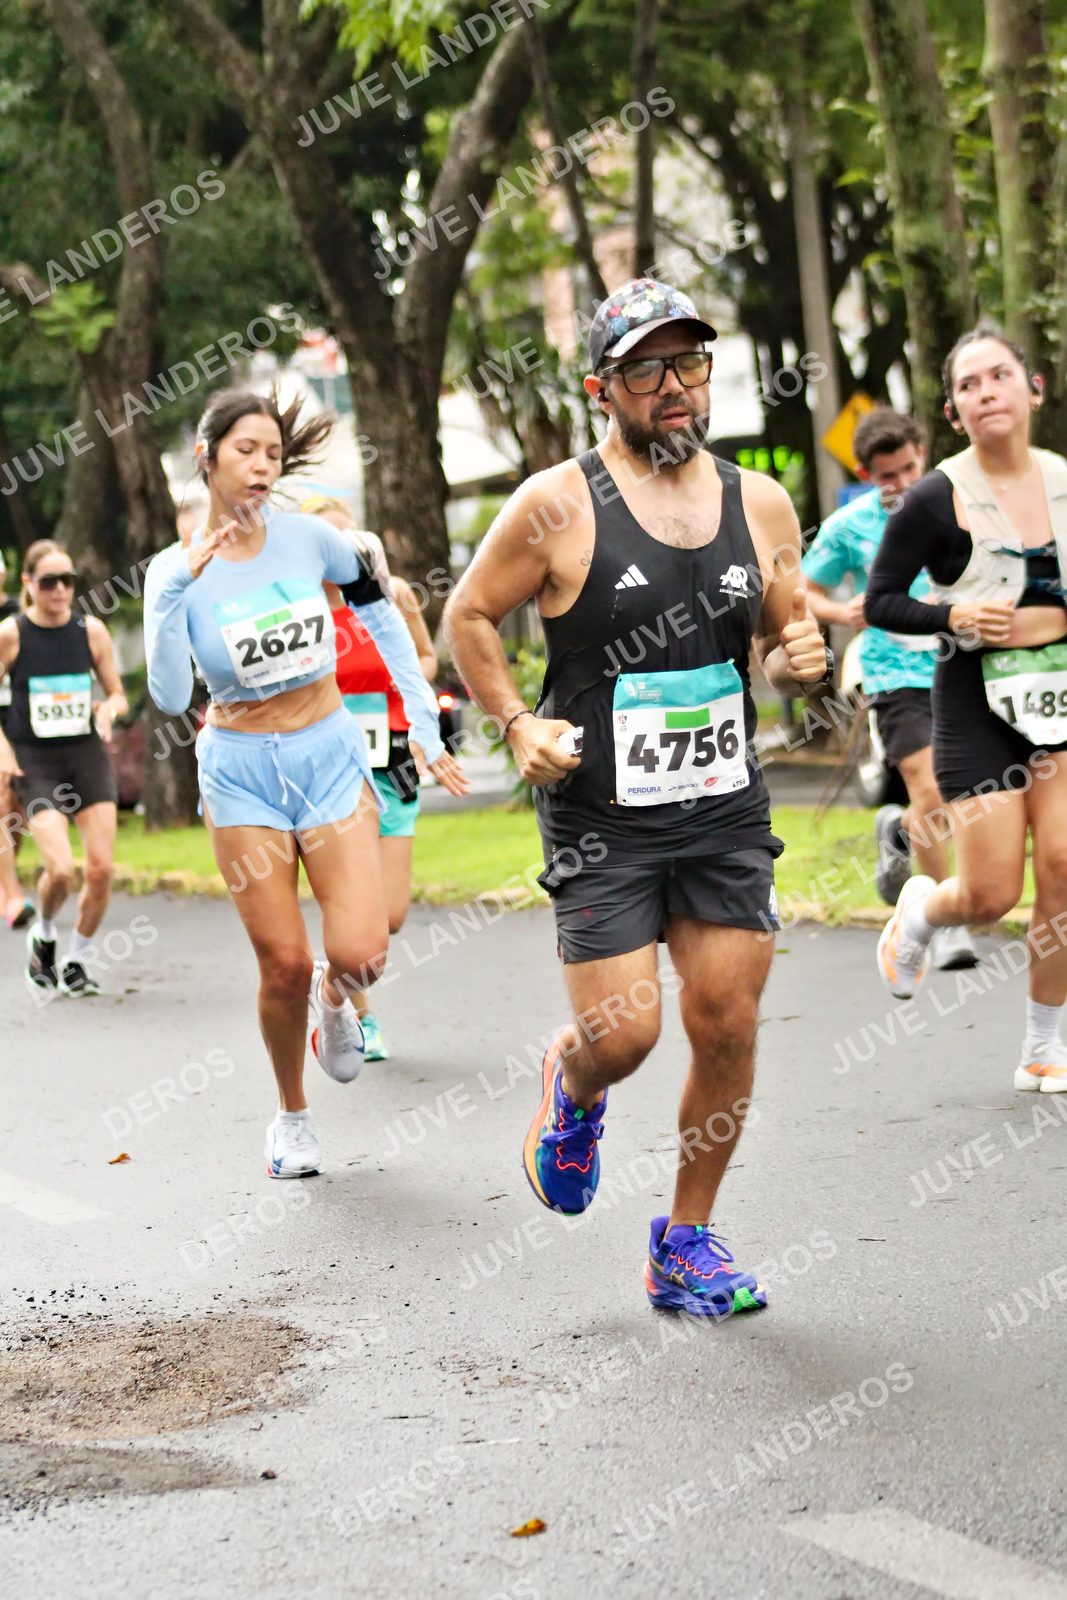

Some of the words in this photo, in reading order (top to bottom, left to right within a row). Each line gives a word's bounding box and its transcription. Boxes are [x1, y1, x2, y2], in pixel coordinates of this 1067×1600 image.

[235, 614, 325, 668] 2627
[627, 719, 739, 773] 4756
[627, 785, 662, 795] PERDURA
